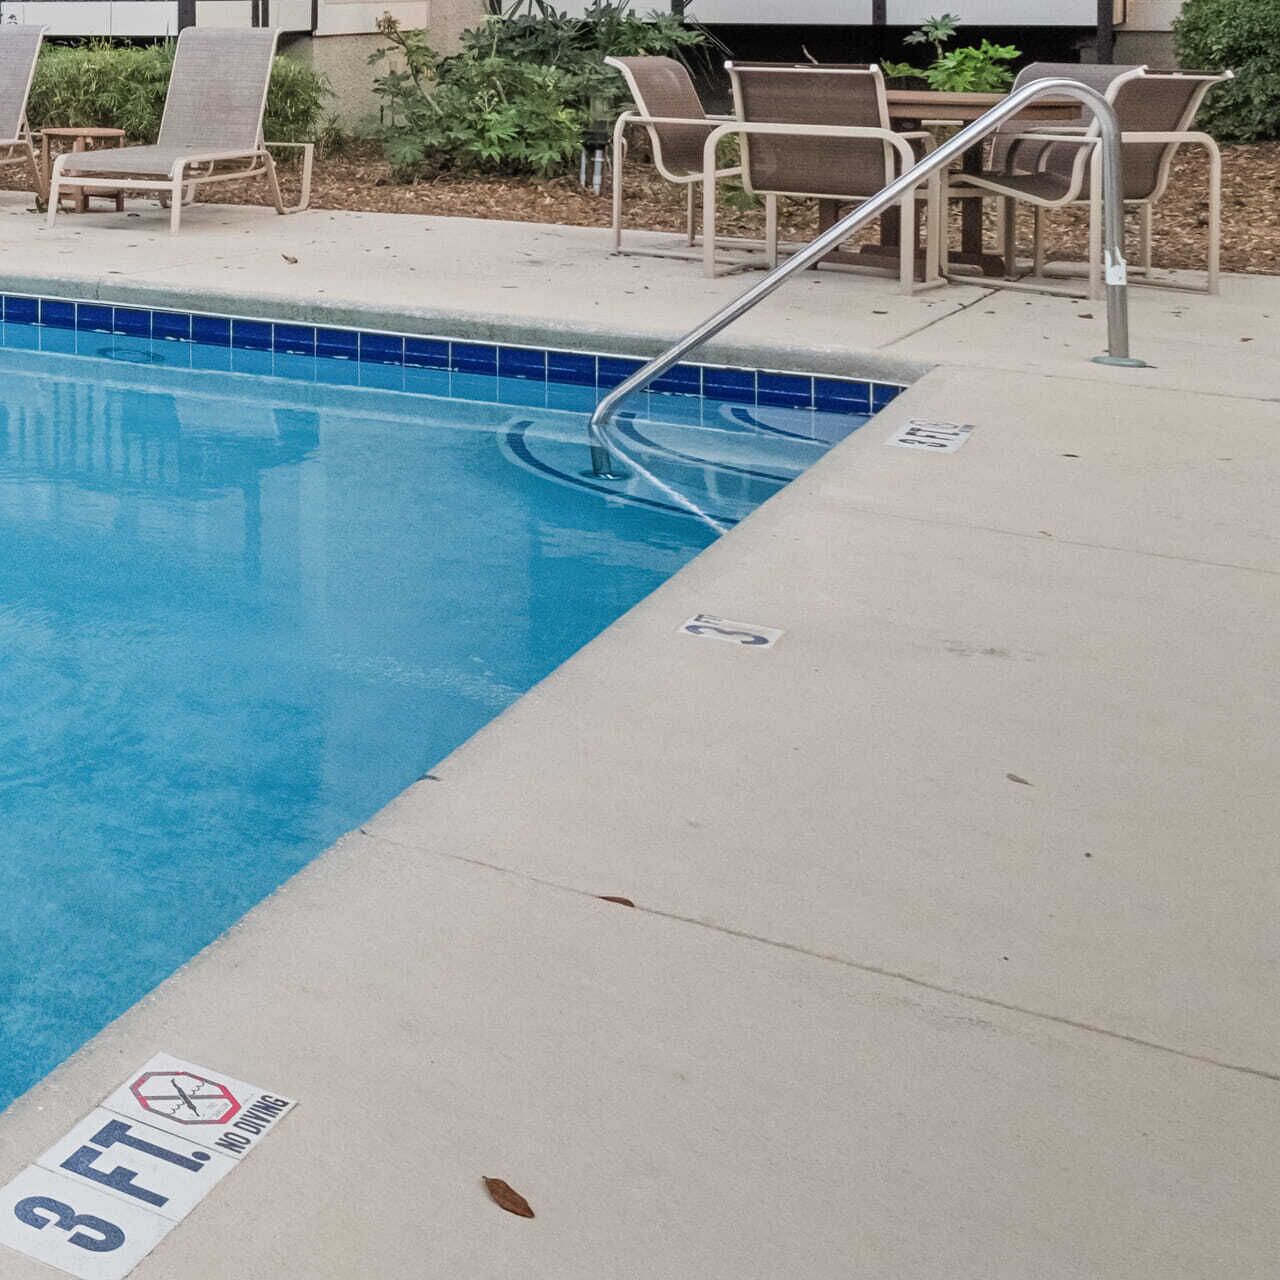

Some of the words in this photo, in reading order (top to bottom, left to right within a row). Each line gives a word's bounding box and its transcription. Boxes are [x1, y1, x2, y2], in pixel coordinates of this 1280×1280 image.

[898, 438, 948, 448] 3
[232, 1094, 290, 1136] DIVING
[59, 1118, 211, 1208] FT.
[214, 1131, 251, 1154] NO
[13, 1195, 126, 1254] 3
